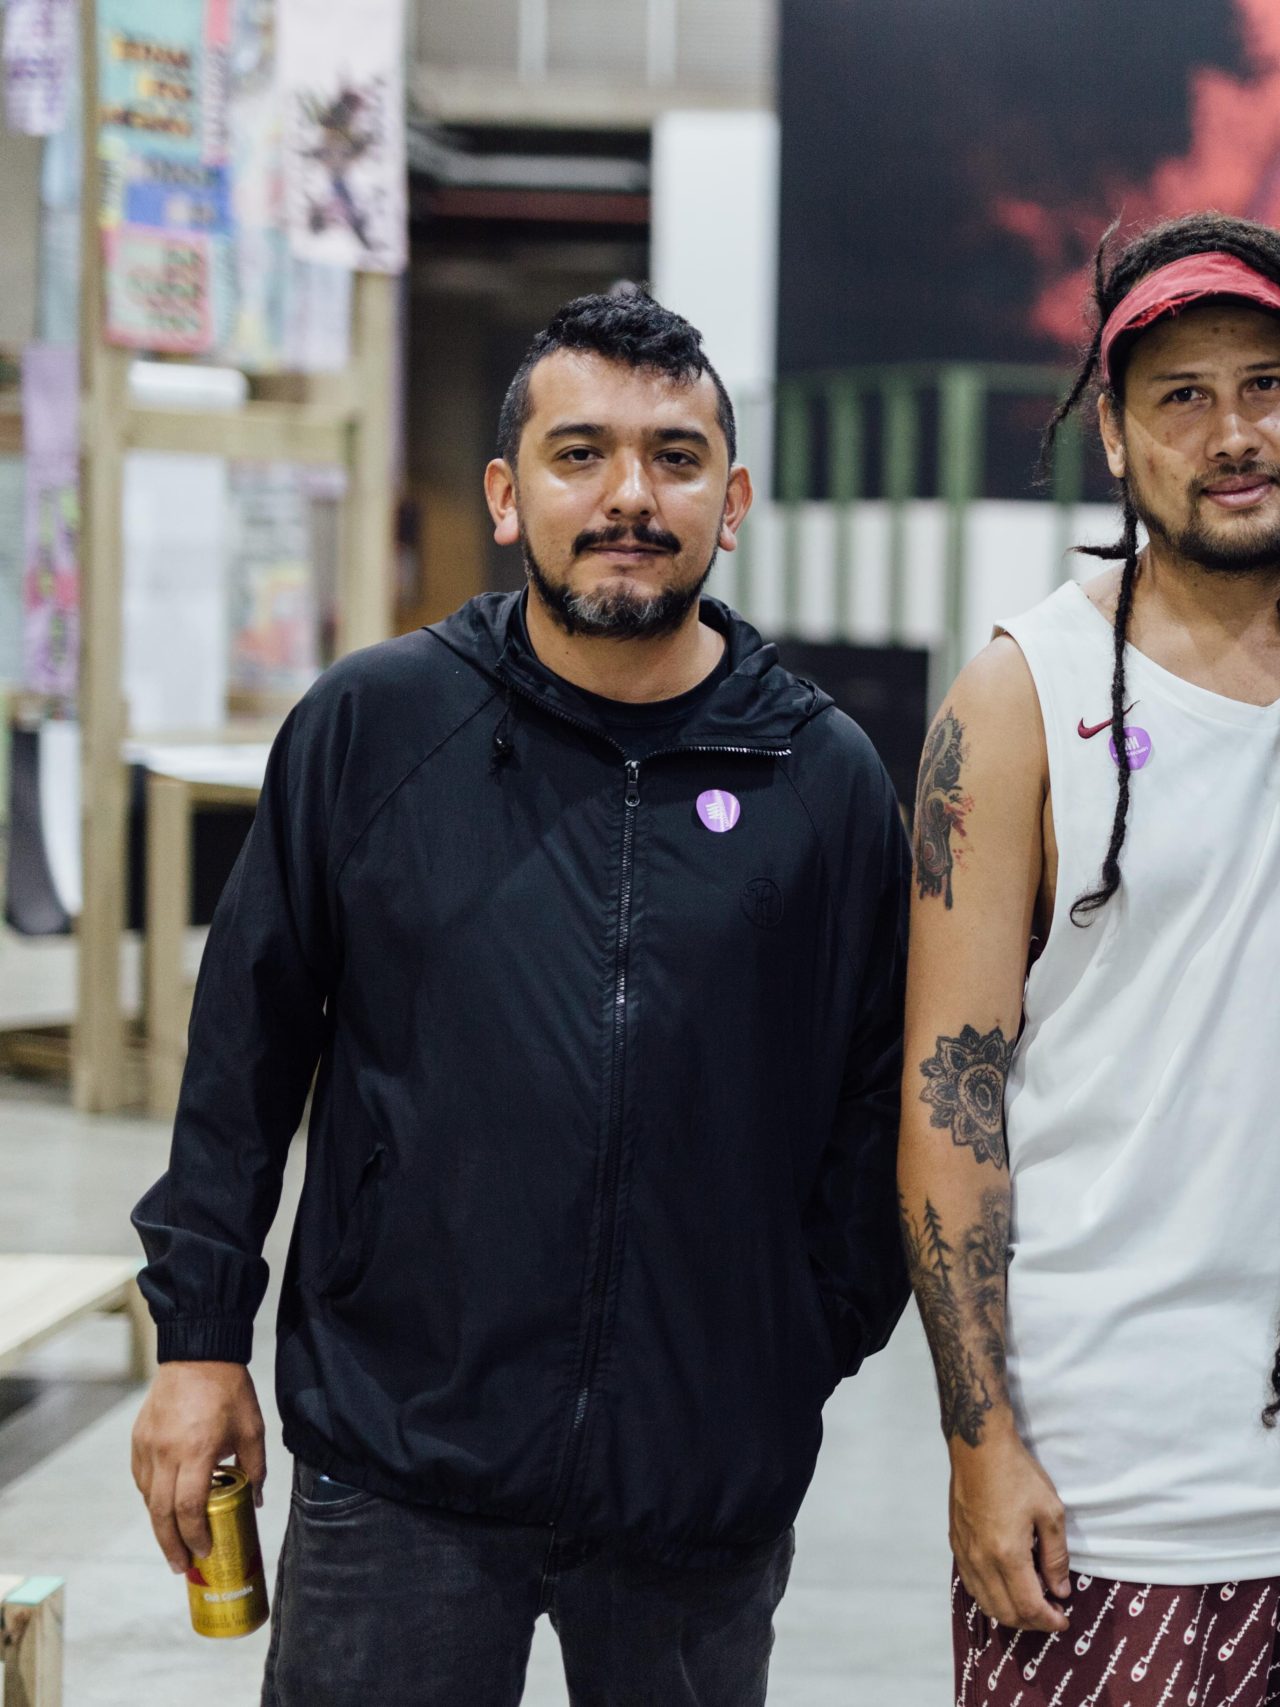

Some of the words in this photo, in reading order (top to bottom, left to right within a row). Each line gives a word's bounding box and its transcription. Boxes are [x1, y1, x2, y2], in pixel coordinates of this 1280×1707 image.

[1023, 1604, 1073, 1681] Champn
[1074, 1580, 1121, 1656] Champio
[1130, 1594, 1180, 1682] Champion
[1218, 1584, 1270, 1661] Champion
